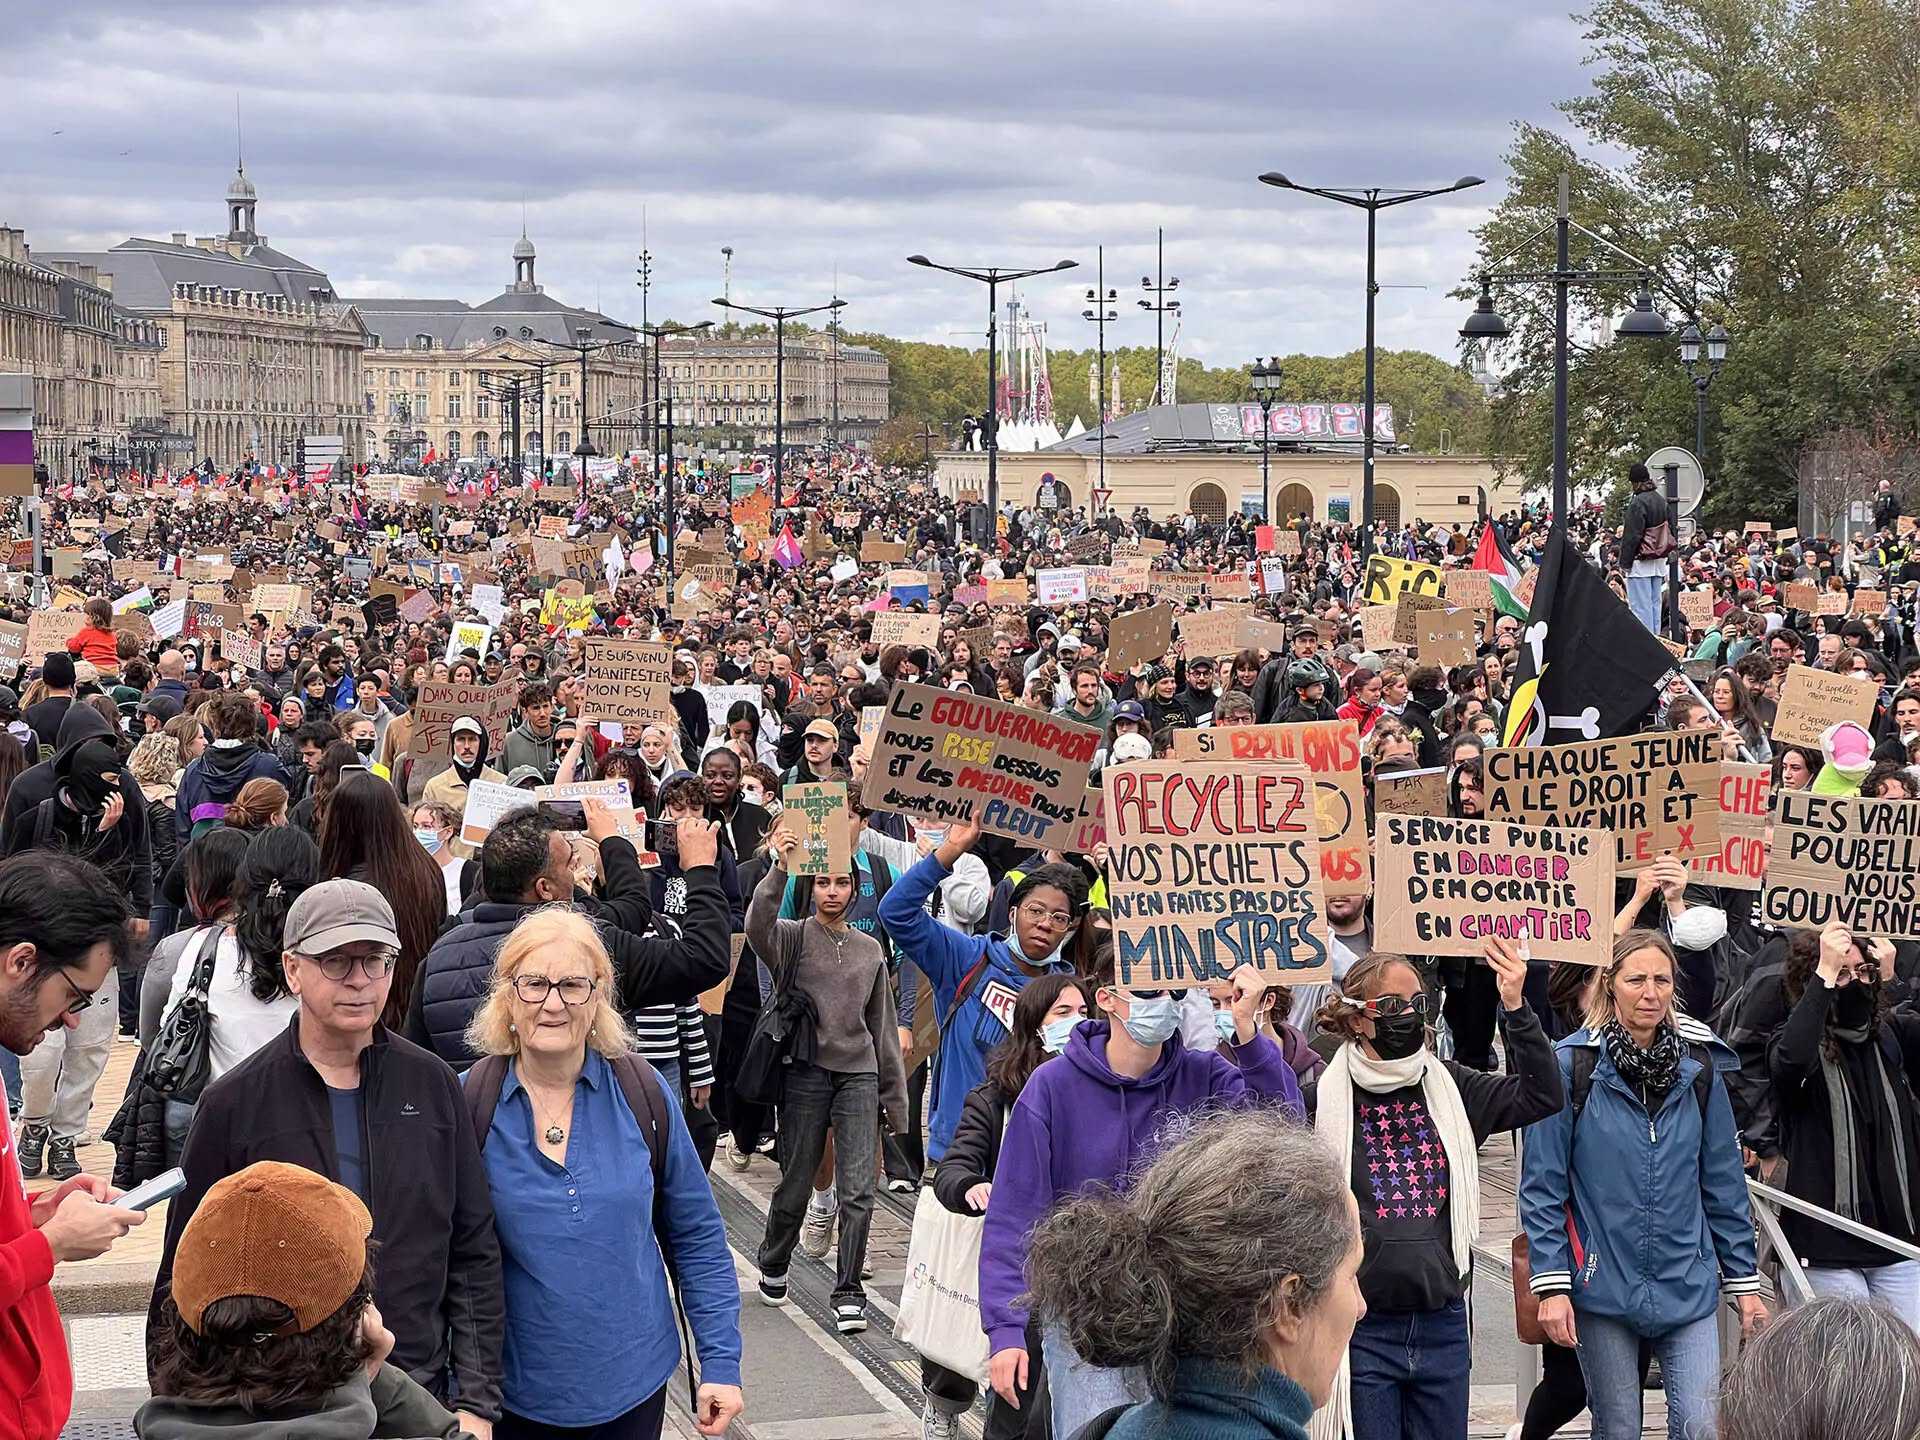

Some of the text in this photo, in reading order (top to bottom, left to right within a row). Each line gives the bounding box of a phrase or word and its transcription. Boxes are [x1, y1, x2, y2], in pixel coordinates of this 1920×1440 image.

[196, 613, 224, 627] 1968
[586, 643, 609, 661] JE
[423, 686, 453, 703] DANS
[586, 684, 652, 699] MON PSY
[890, 689, 924, 720] Le
[617, 704, 665, 719] COMPLET
[992, 754, 1061, 787] DESSUS
[1488, 732, 1721, 781] CHAQUE JEUNE
[617, 782, 627, 793] 5
[804, 786, 823, 797] LA
[956, 767, 1035, 805] MEDIAS
[1489, 786, 1511, 813] A
[1523, 782, 1559, 811] LE
[1569, 771, 1652, 808] DROIT
[983, 798, 1054, 839] PLEUT
[1113, 772, 1307, 836] RECYCLEZ
[1663, 792, 1698, 823] ET
[1781, 796, 1920, 836] LES VRAI
[1108, 840, 1310, 888] VOS DECHETS
[1413, 850, 1570, 881] EN DANGER
[1790, 831, 1920, 874] POUBELL
[1111, 888, 1315, 919] N'EN FAITES PAS DES
[1844, 873, 1916, 903] NOUS
[1416, 911, 1452, 941] EN
[1118, 911, 1328, 985] MINISTRES
